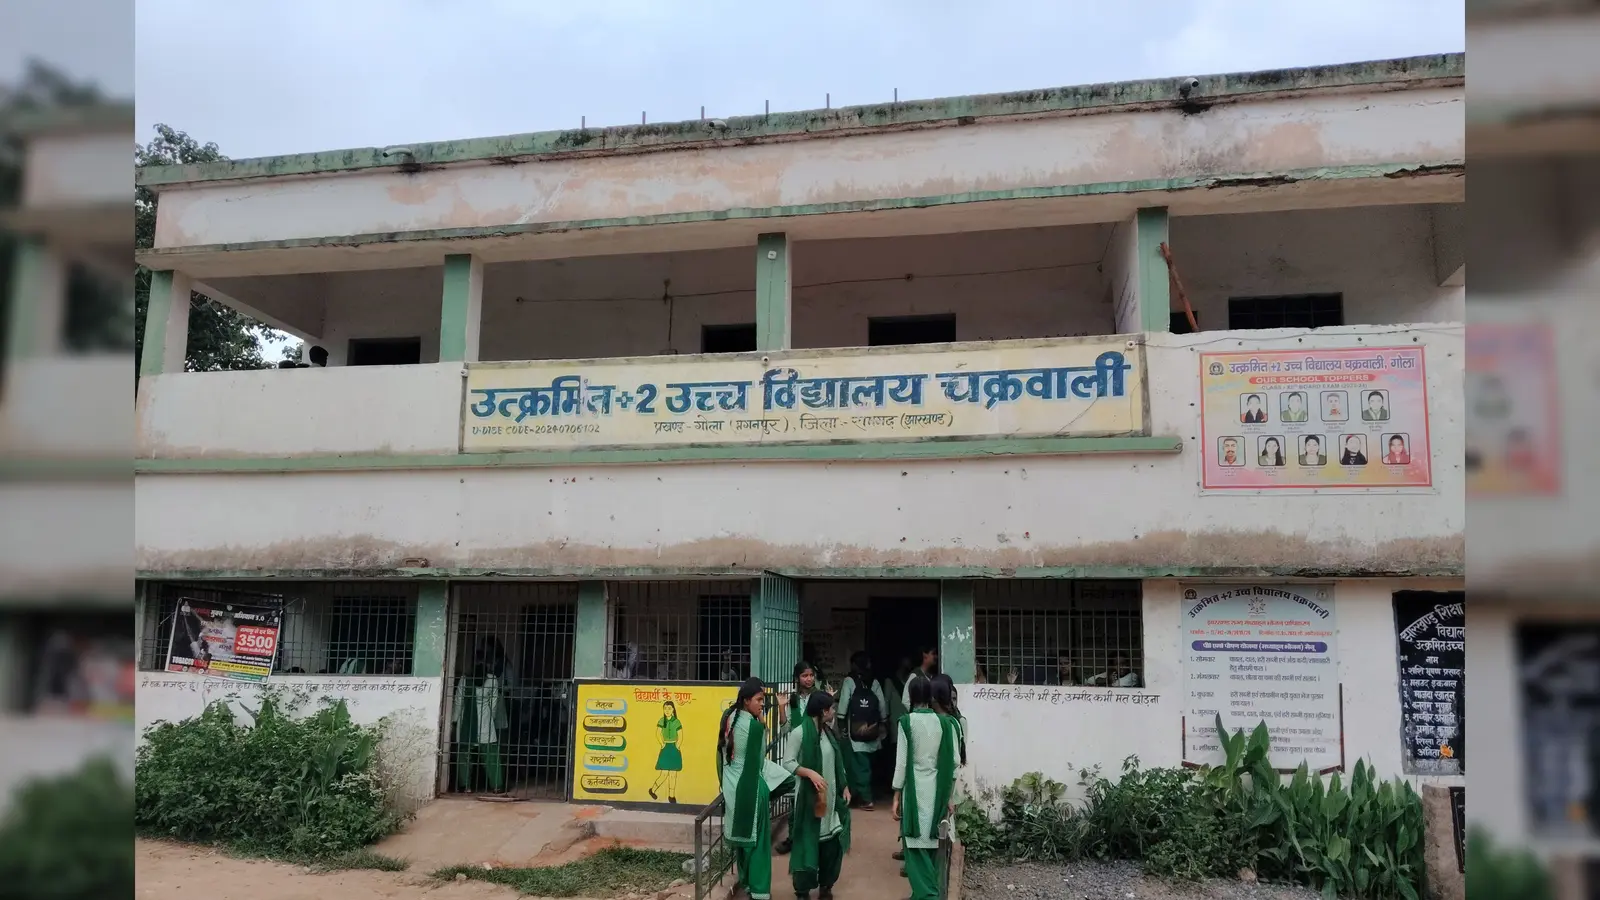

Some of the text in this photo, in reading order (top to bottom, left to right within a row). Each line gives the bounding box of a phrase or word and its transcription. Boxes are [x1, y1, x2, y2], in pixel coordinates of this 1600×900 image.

[1229, 359, 1268, 375] उत्क्रमित
[1270, 362, 1281, 372] +2
[1284, 361, 1303, 371] उच्च
[1305, 357, 1342, 371] विद्यालय
[1391, 355, 1416, 370] गोला
[665, 381, 752, 413] उच्च
[760, 367, 929, 410] विद्यालय
[936, 352, 1131, 410] चक्रवाली
[1323, 374, 1369, 382] TOPPERS
[694, 414, 725, 435] गोला
[1220, 590, 1233, 601] +2
[1434, 602, 1464, 620] शिक्षा
[237, 634, 274, 649] 3500
[1415, 638, 1465, 652] उत्क्रमित उच्च
[1425, 655, 1439, 664] नाम
[368, 683, 379, 691] का
[379, 680, 396, 692] कोई
[662, 688, 673, 701] के
[674, 691, 692, 706] गुण
[973, 688, 1011, 702] परिस्थिति
[1013, 687, 1035, 701] कैसी
[1037, 689, 1050, 701] भी
[1064, 689, 1092, 703] उम्मीद
[1093, 689, 1112, 702] कभी
[1115, 691, 1130, 704] मत
